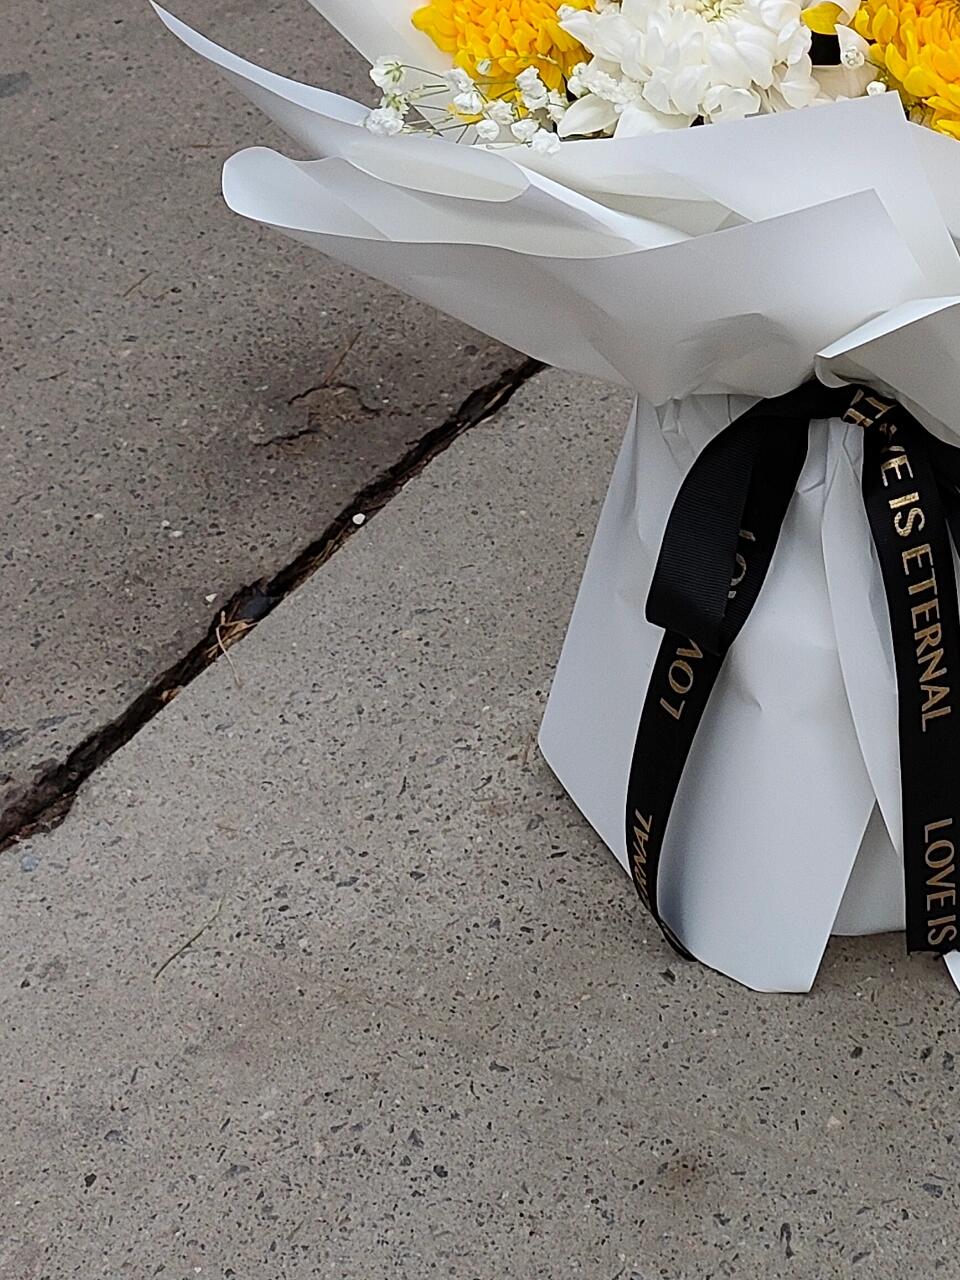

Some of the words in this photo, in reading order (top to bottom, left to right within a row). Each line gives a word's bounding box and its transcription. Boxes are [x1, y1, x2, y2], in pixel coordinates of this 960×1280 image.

[889, 492, 925, 537] IS
[659, 637, 703, 720] LOV
[902, 543, 951, 733] ETERNAL
[924, 818, 956, 912] LOVE
[927, 915, 957, 945] IS
